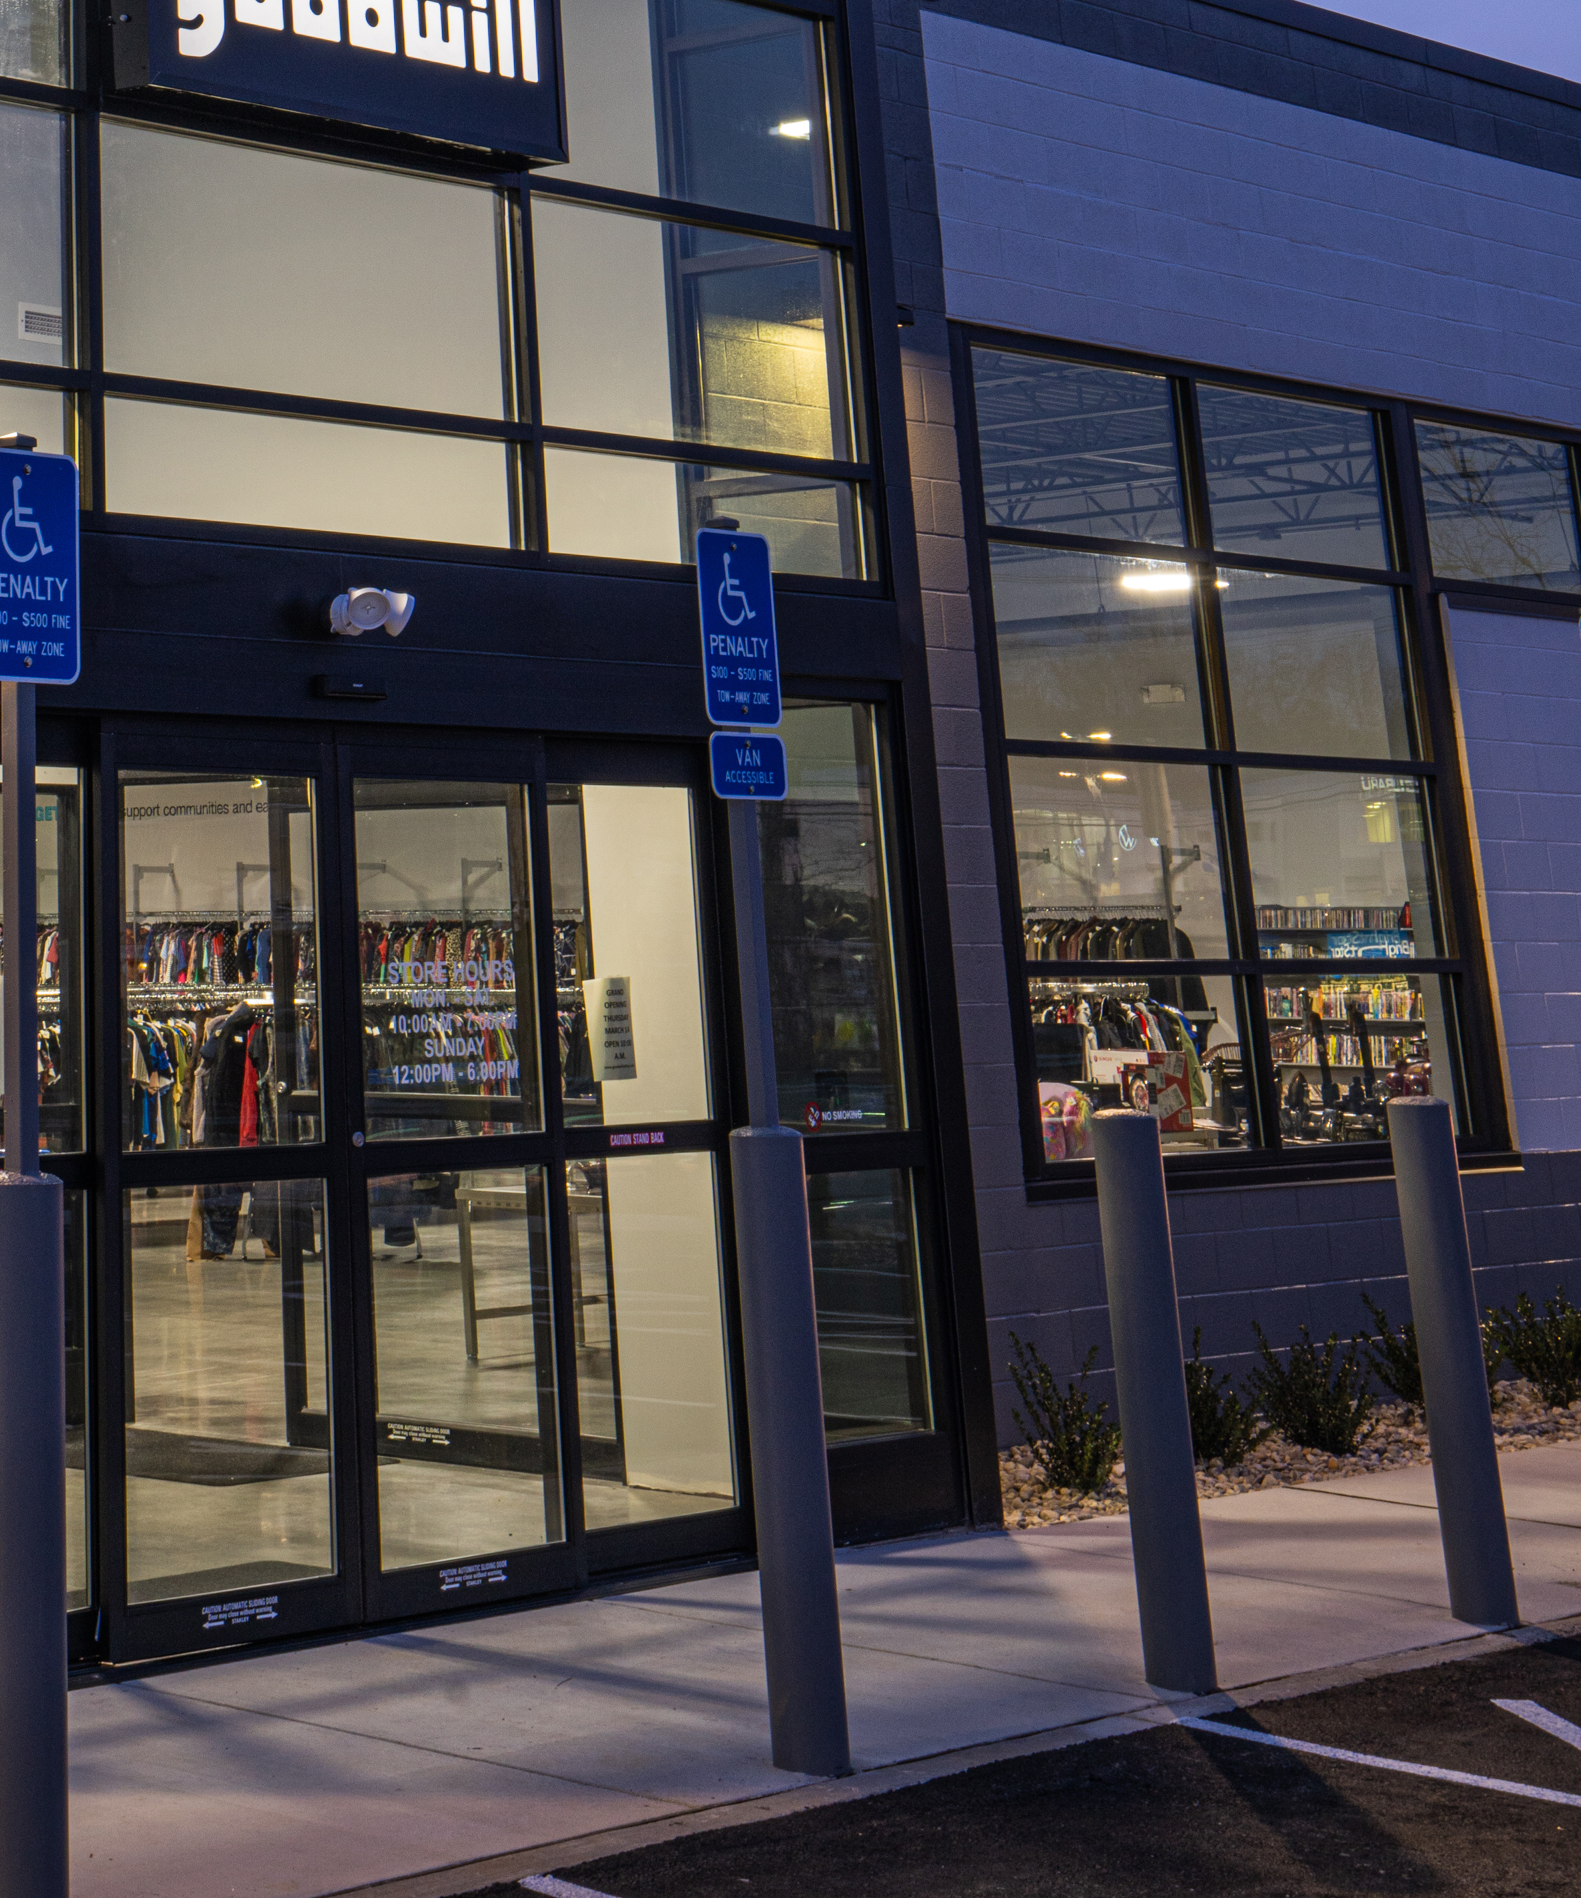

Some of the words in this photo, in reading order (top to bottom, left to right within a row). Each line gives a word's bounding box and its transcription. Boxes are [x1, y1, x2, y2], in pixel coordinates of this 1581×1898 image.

[22, 611, 49, 629] $500
[52, 614, 71, 630] FINE
[41, 641, 65, 657] ZONE
[710, 634, 769, 659] PENALTY
[711, 665, 728, 679] $100
[737, 667, 756, 681] $500
[758, 668, 773, 682] FINE
[717, 689, 750, 704] TOW-AWAY
[752, 691, 770, 706] ZONE
[736, 748, 761, 767] VAN
[725, 770, 775, 785] ACCESSIBLE
[163, 801, 229, 817] communities
[232, 800, 253, 815] and
[388, 962, 448, 984] STORE
[453, 961, 514, 982] HOURS
[391, 1014, 453, 1034] 10:00AM
[424, 1038, 485, 1058] SUNDAY
[393, 1063, 454, 1085] 12:00PM
[822, 1111, 832, 1121] NO
[832, 1109, 863, 1121] SMOKING
[610, 1133, 632, 1146] CAUTION
[633, 1132, 650, 1145] STAND
[650, 1131, 665, 1144] BACK
